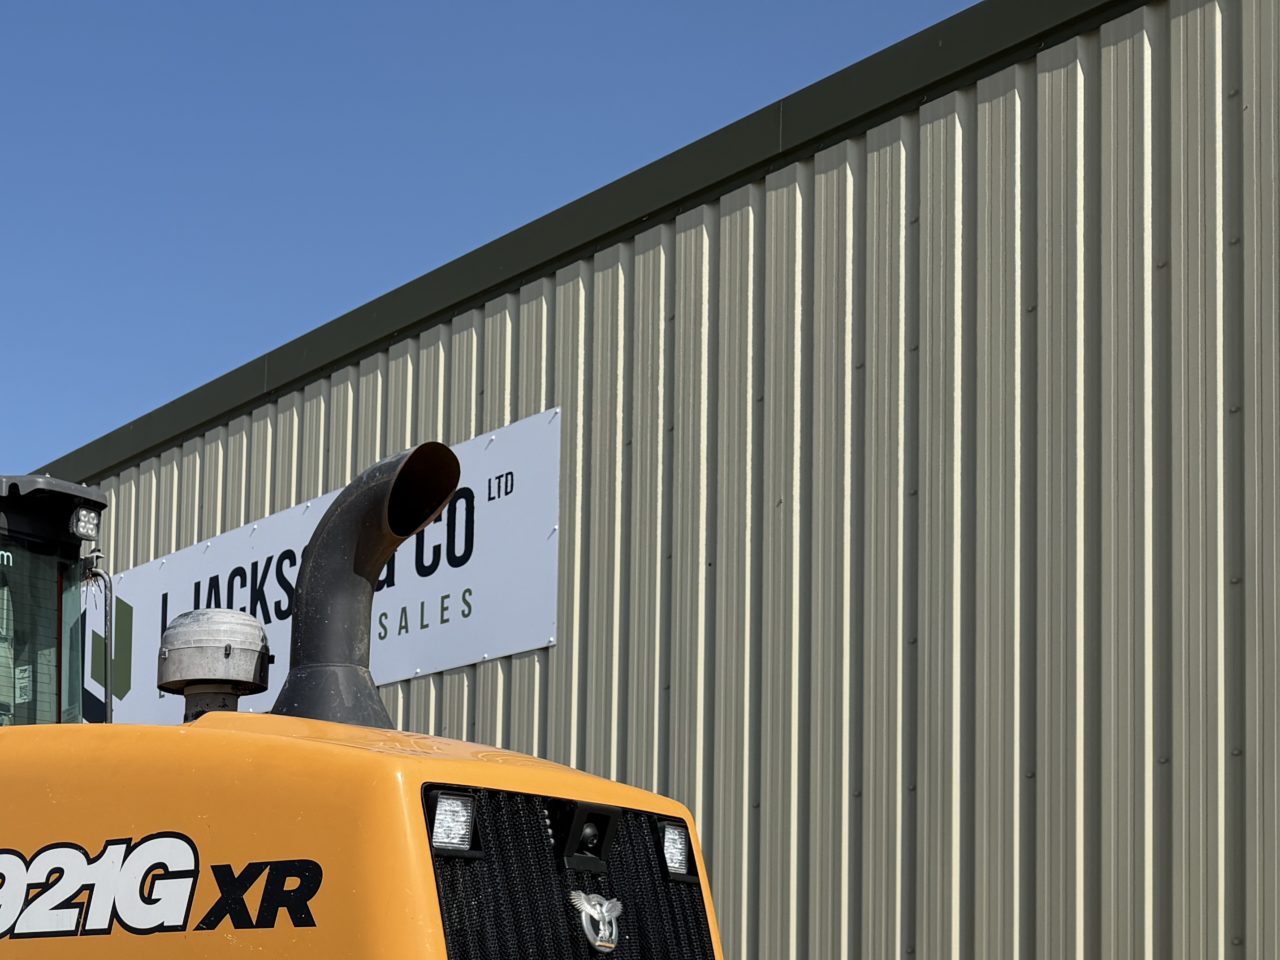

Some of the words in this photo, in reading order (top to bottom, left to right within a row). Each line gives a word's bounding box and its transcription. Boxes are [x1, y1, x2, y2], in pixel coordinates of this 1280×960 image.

[193, 549, 308, 625] ACKS
[488, 471, 514, 502] LTD
[378, 588, 472, 640] SALES
[193, 859, 323, 931] XR
